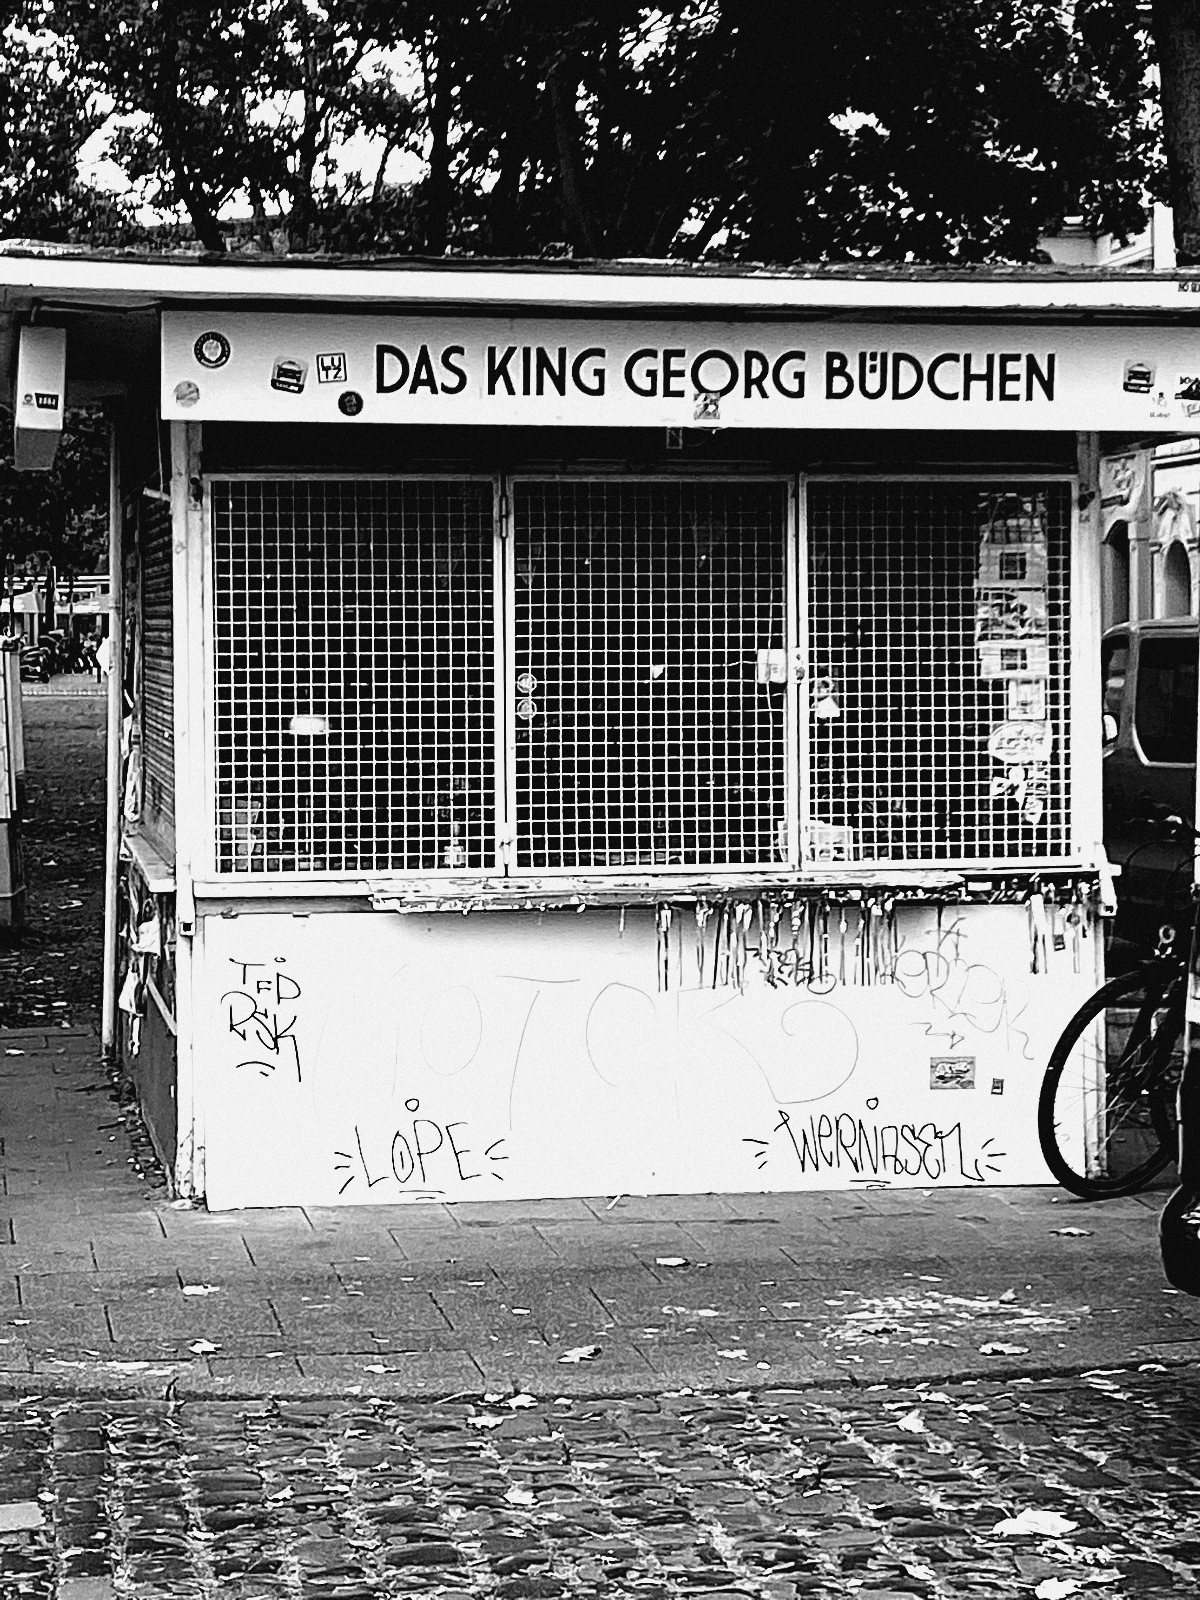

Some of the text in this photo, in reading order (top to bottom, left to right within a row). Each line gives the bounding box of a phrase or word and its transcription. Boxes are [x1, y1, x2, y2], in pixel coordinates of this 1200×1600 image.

[377, 345, 1055, 401] DAS KING GEORG BÜDCHEN
